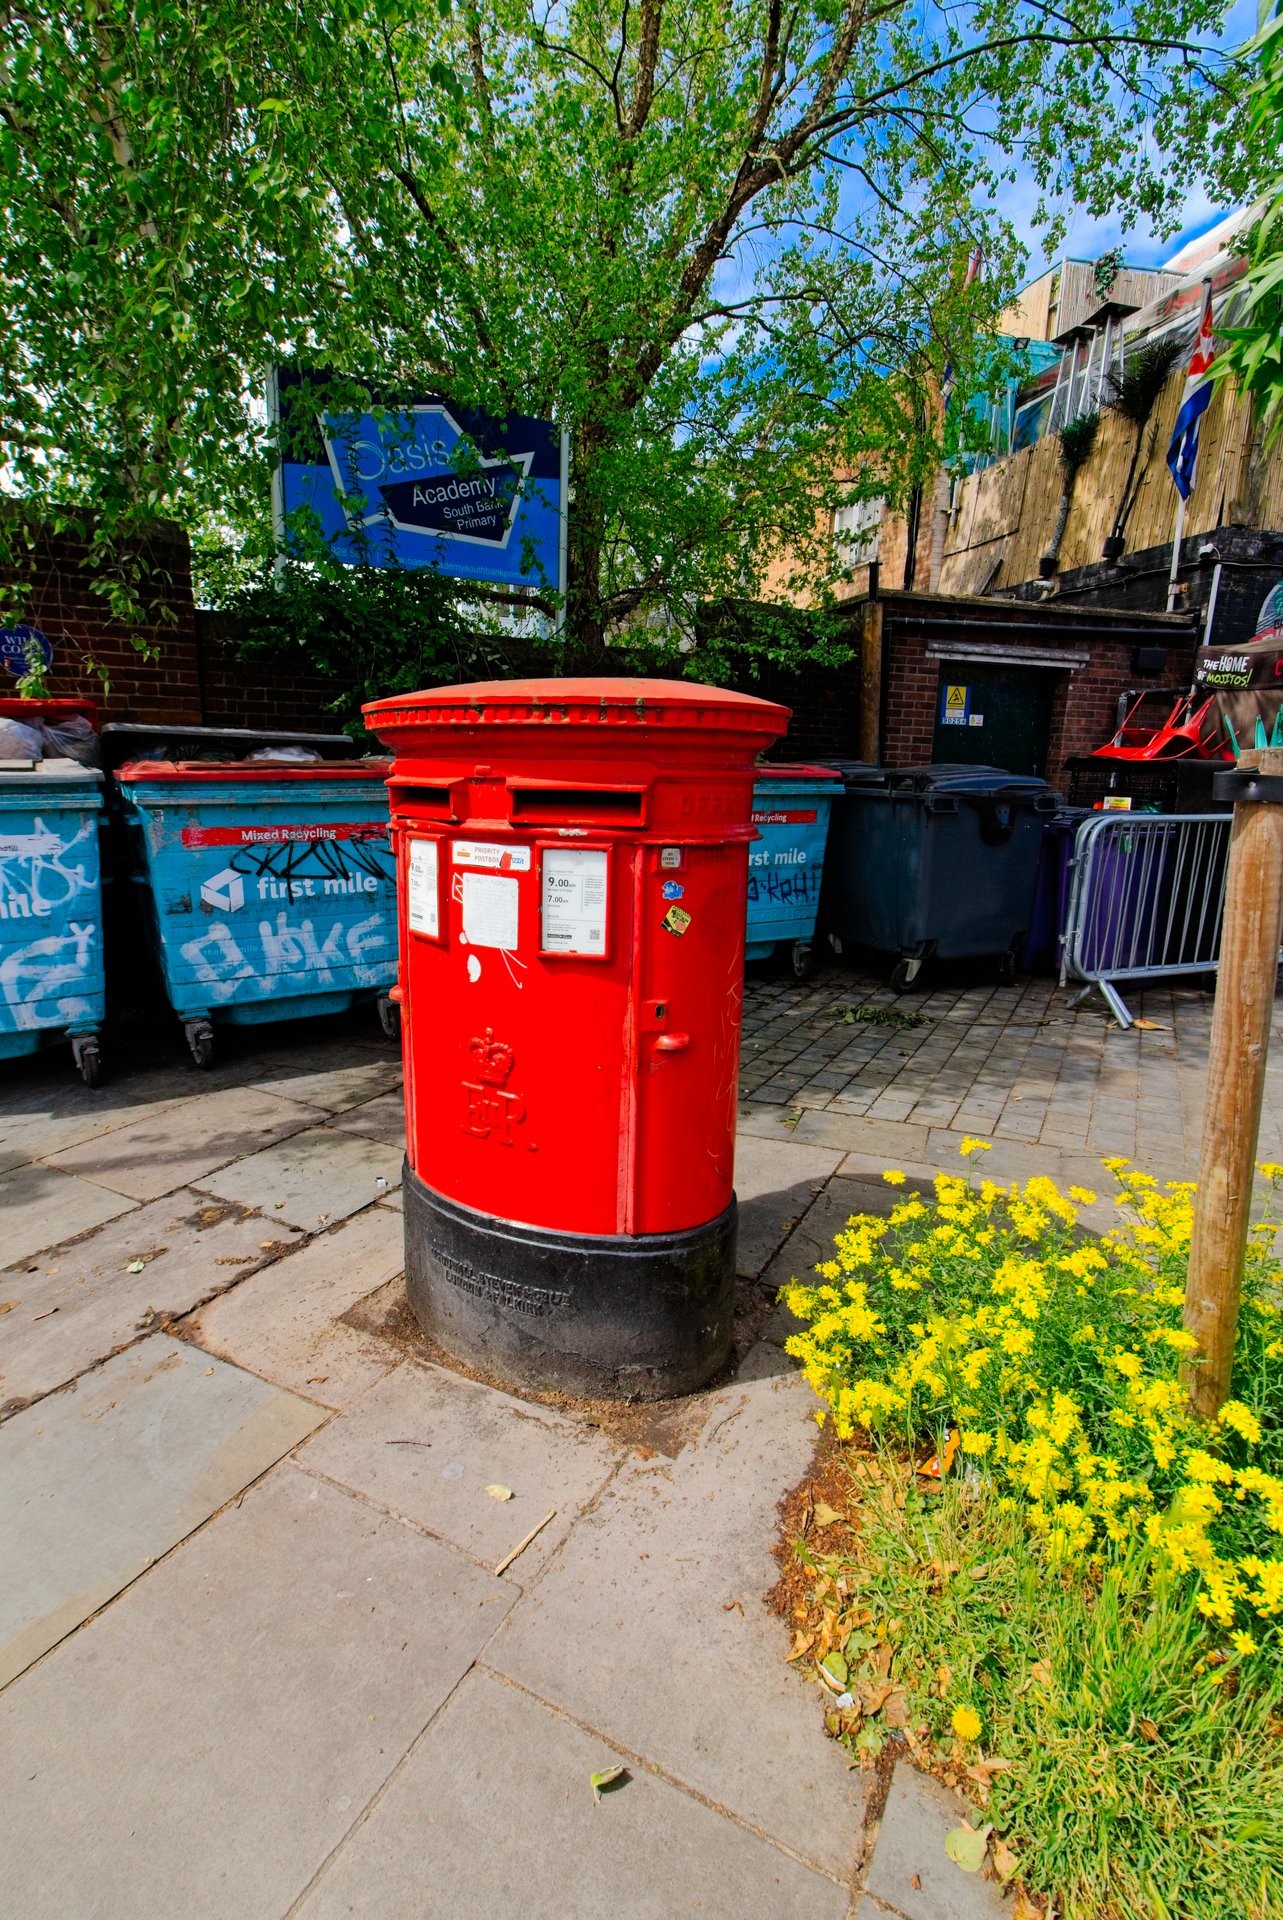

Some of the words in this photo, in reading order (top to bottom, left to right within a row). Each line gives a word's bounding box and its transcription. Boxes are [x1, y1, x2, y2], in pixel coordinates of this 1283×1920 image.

[347, 434, 452, 480] Oasis
[413, 477, 495, 507] Academy
[443, 503, 475, 519] South
[456, 514, 497, 530] Primary
[1203, 659, 1219, 670] THE
[1219, 655, 1250, 672] HOME
[1207, 668, 1253, 688] MOJITOS!
[755, 813, 787, 823] Recycling
[241, 830, 279, 841] Mixed
[282, 828, 336, 841] Recycling
[748, 851, 769, 866] rst
[774, 848, 807, 865] mile
[257, 877, 316, 899] first
[324, 872, 378, 895] mile
